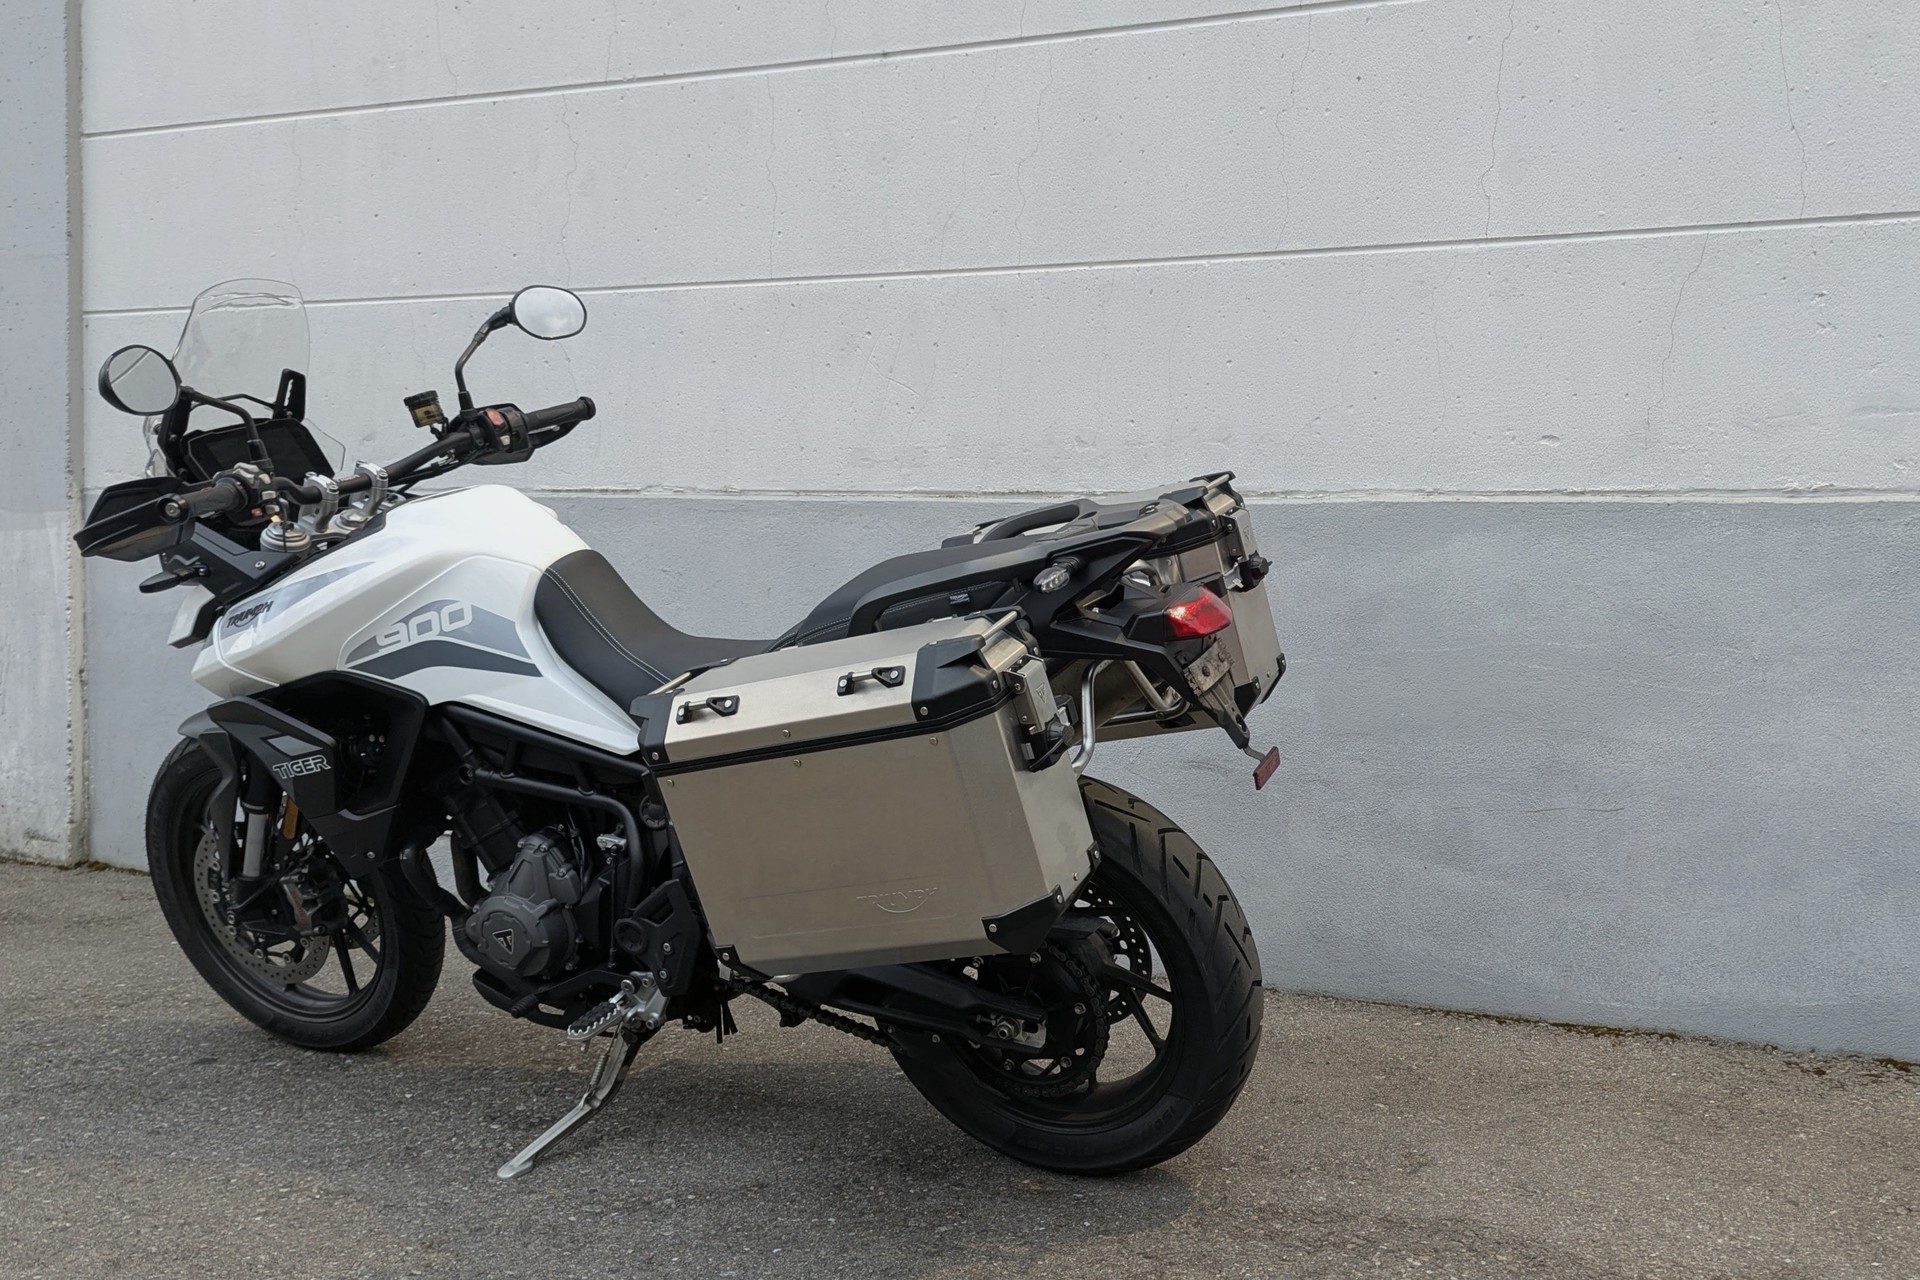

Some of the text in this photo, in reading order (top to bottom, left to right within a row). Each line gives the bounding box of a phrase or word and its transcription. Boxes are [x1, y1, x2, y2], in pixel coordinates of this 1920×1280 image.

[226, 600, 274, 628] TRIUMPH
[376, 601, 473, 651] 900
[272, 754, 332, 779] TIGER
